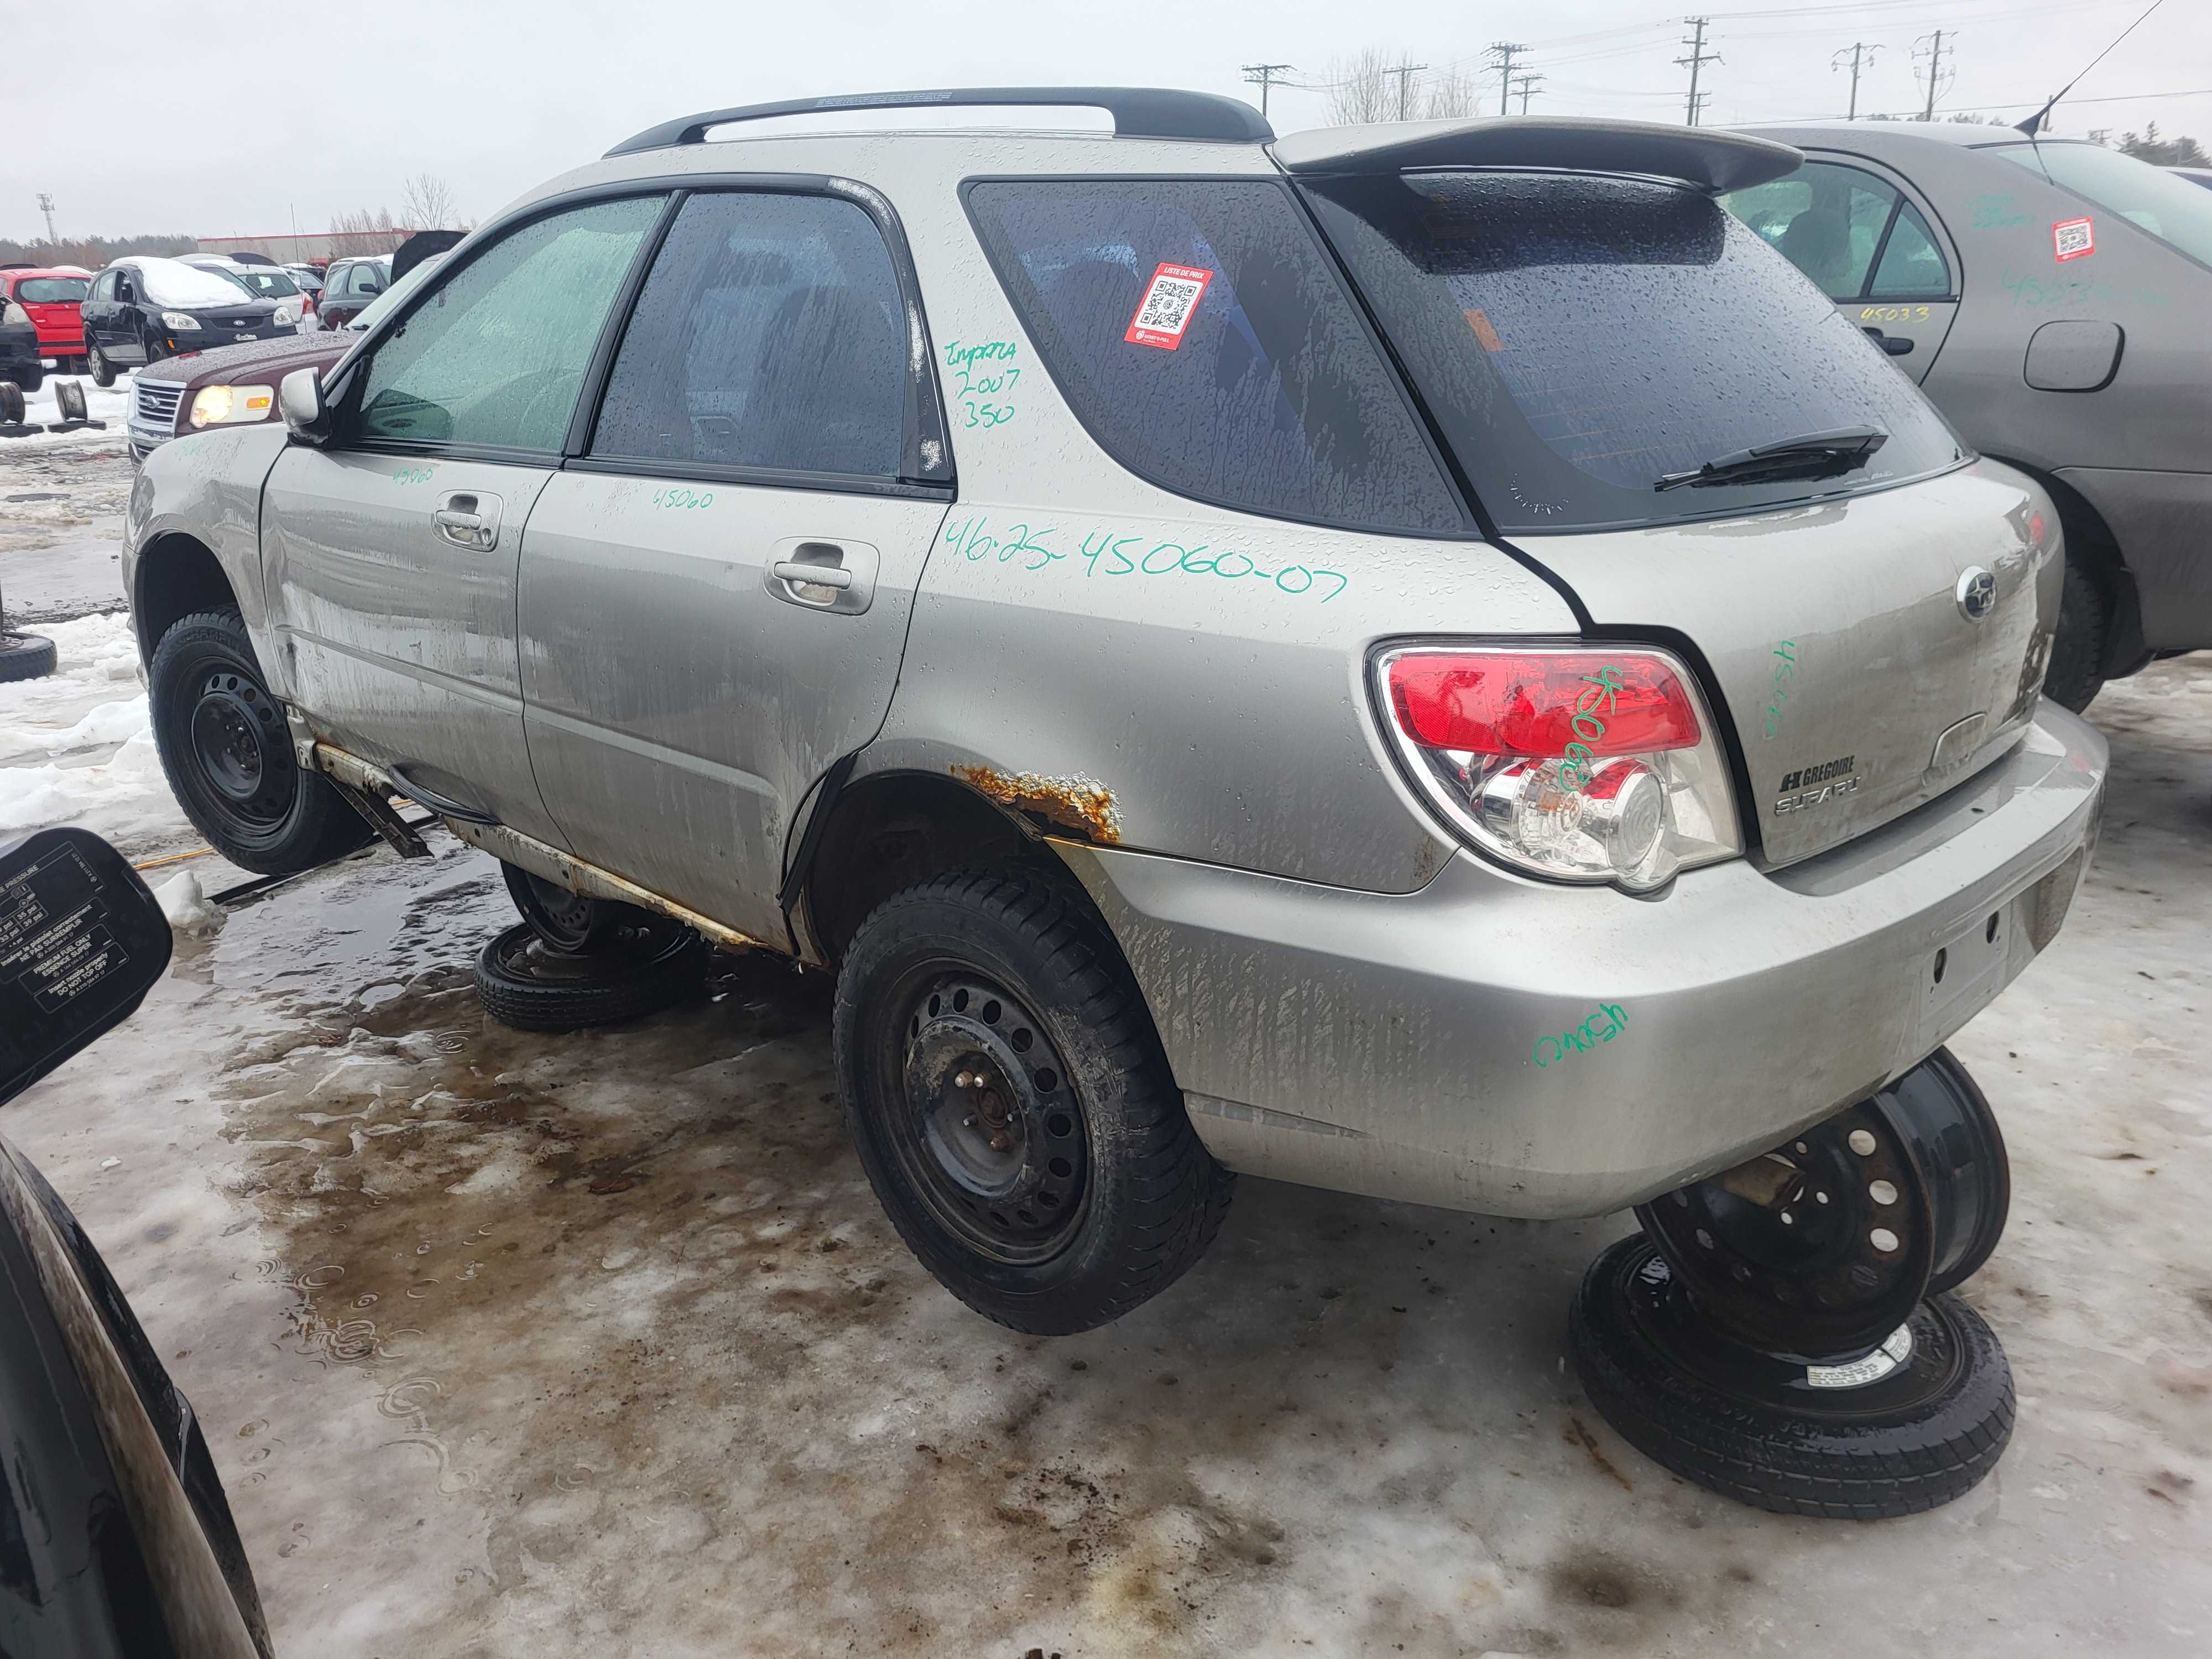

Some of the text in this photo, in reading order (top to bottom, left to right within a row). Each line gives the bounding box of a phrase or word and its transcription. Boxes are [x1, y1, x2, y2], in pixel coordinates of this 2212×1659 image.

[1164, 267, 1181, 275] LISTE
[1860, 306, 1929, 323] 45033
[955, 369, 1020, 399] 2007
[965, 401, 1015, 428] 350
[653, 488, 713, 510] 45060
[1803, 755, 1855, 786] GREGOIRE
[5, 864, 39, 889] PRESSURE
[17, 905, 37, 920] 35 psi
[23, 911, 43, 927] 39 psi
[30, 930, 54, 948] pistolet
[53, 904, 93, 932] correctement
[9, 927, 20, 938] psi
[20, 919, 83, 962] NE PAS SURREMPLIR
[33, 933, 91, 974] PREMIUM FUEL ONLY
[41, 942, 92, 977] ESSENCE SUPER
[48, 952, 108, 994] Insert nozzle properly
[58, 959, 107, 995] DO NOT TOP OFF
